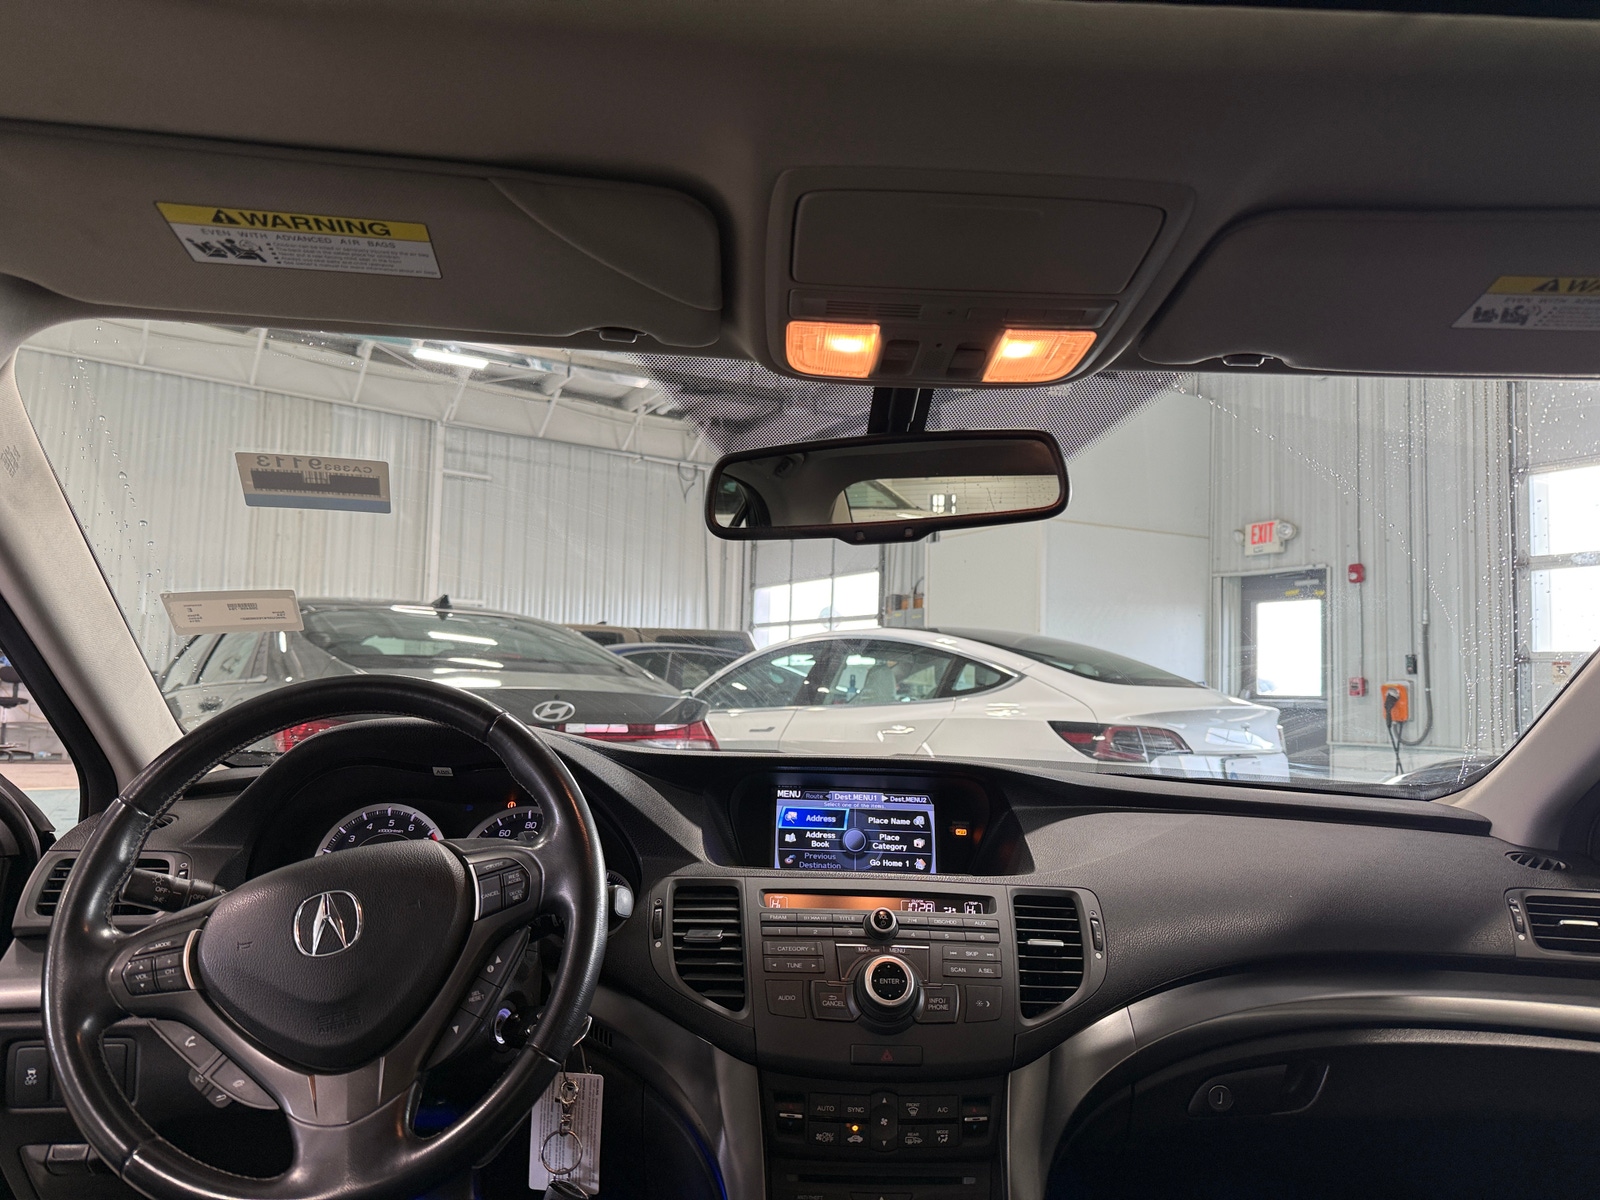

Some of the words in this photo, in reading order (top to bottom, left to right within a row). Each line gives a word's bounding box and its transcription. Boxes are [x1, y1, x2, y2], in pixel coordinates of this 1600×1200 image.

[239, 211, 391, 237] WARNING
[201, 228, 231, 237] EVEN
[237, 230, 268, 240] WITH
[276, 233, 332, 245] ADVANCED
[340, 238, 360, 246] AIR
[367, 240, 396, 249] BAGS
[1251, 522, 1275, 545] EXIT
[777, 790, 801, 798] MENU
[388, 819, 395, 827] 5
[806, 815, 836, 823] Address
[868, 817, 889, 825] Place
[408, 824, 415, 832] 6
[525, 821, 537, 829] 80
[498, 829, 511, 838] 60
[348, 835, 356, 843] 3
[872, 843, 907, 852] Category
[799, 861, 841, 869] Destination
[870, 859, 880, 867] Go
[481, 890, 500, 899] CANCEL
[928, 1003, 949, 1011] PHONE
[24, 1078, 37, 1086] OFF
